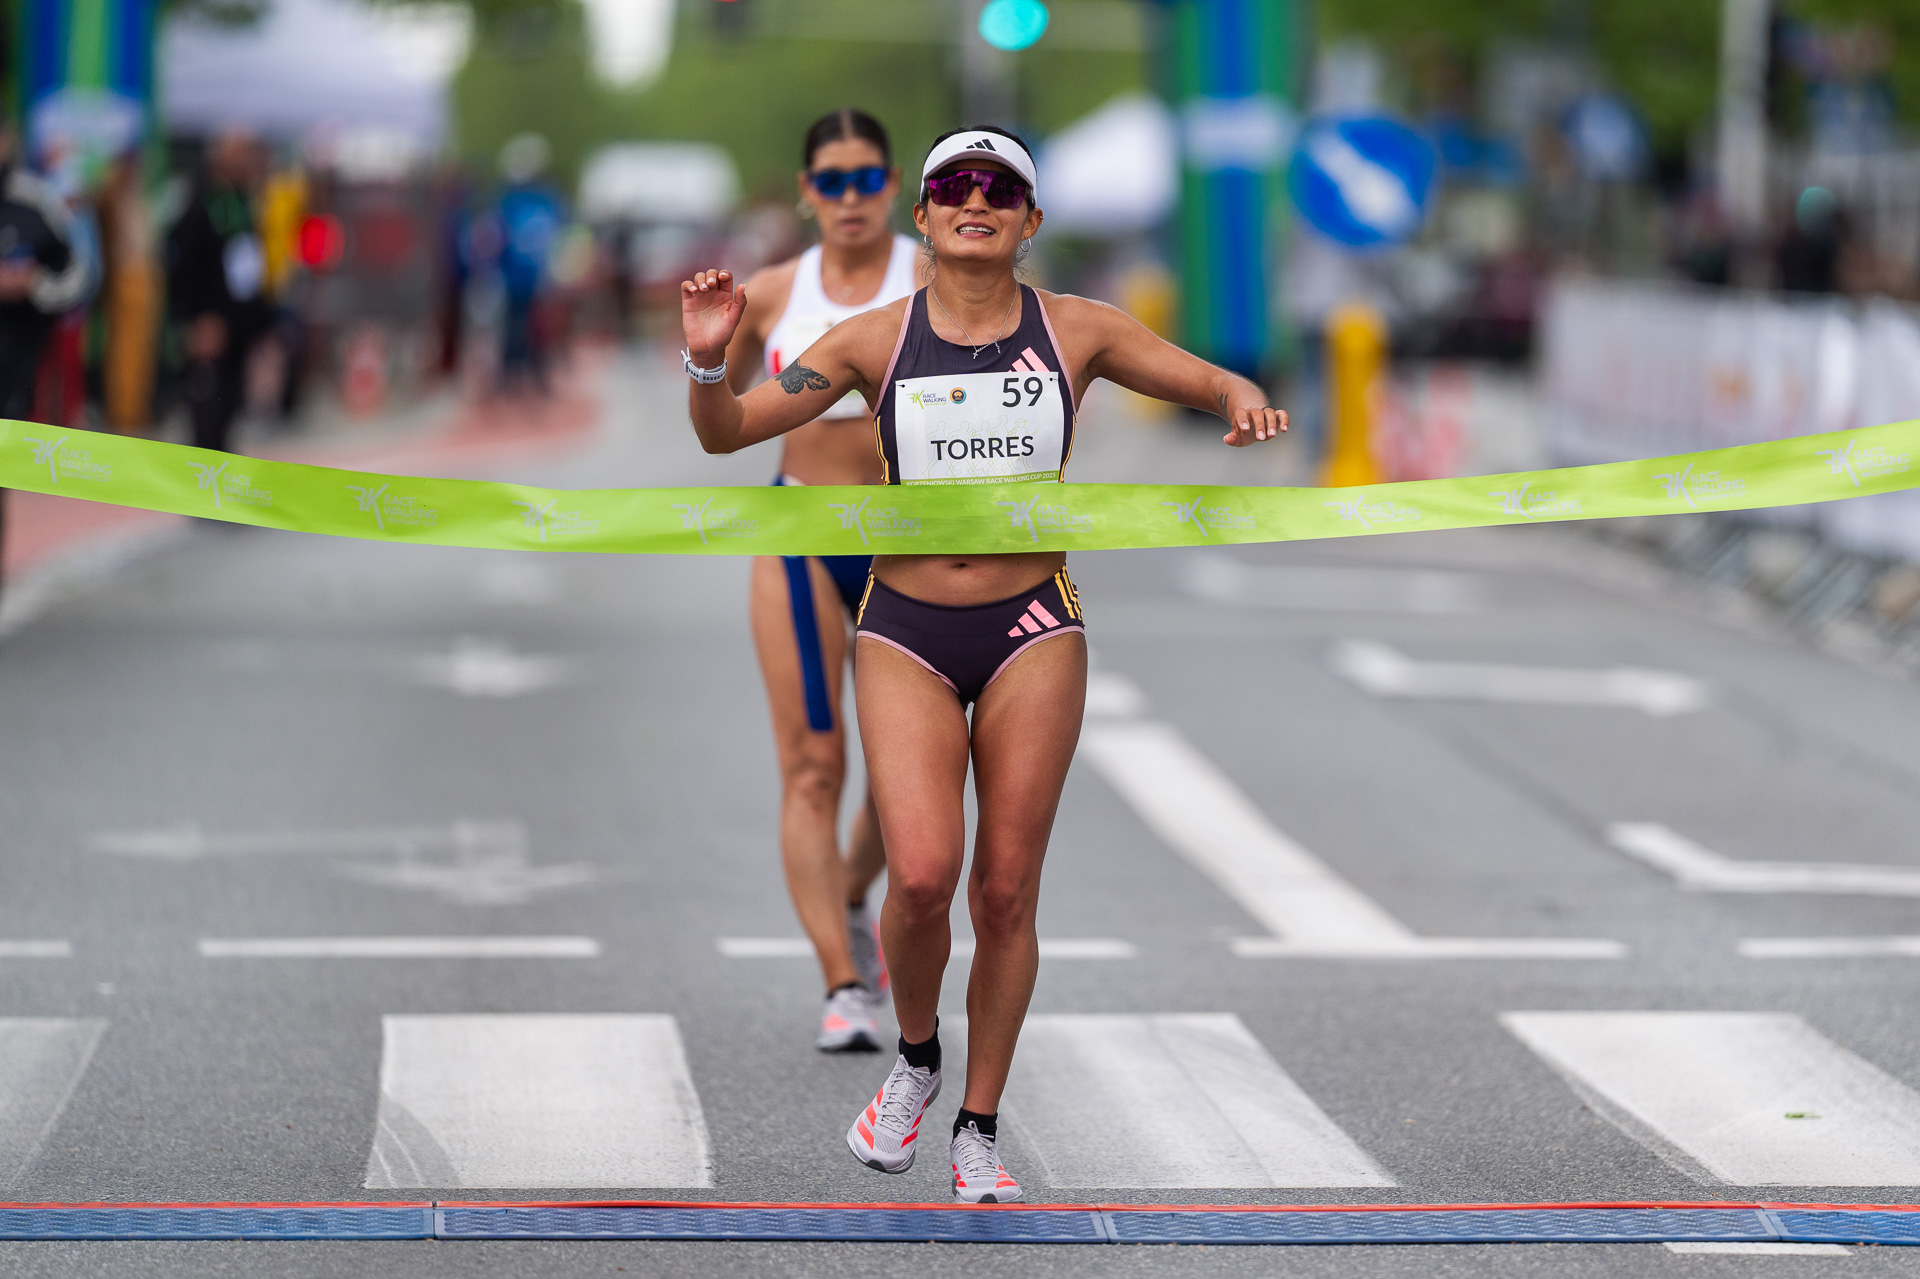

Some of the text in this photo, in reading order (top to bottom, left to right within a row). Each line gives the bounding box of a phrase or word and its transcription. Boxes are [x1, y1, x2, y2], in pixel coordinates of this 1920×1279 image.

[1002, 376, 1043, 408] 59
[60, 447, 92, 461] RACE
[930, 435, 1034, 461] TORRES
[1854, 446, 1886, 460] RACE
[60, 458, 111, 475] WALKING
[1855, 453, 1910, 470] WALKING
[1895, 464, 1910, 473] CUP
[223, 473, 252, 486] RACE
[1003, 475, 1030, 483] WALKING
[1690, 470, 1721, 484] RACE
[223, 483, 272, 500] WALKING
[1691, 478, 1745, 495] WALKING
[384, 494, 415, 506] RACE
[1527, 492, 1557, 503] RACE
[1036, 505, 1069, 515] RACE
[1200, 506, 1231, 516] RACE
[1362, 501, 1395, 511] RACE
[1527, 500, 1582, 512] WALKING
[384, 505, 438, 520] WALKING
[550, 510, 582, 520] RACE
[708, 507, 738, 519] RACE
[866, 507, 898, 518] RACE
[1364, 507, 1420, 519] WALKING
[550, 519, 600, 530] WALKING
[707, 519, 760, 530] WALKING
[866, 518, 922, 529] WALKING
[1037, 514, 1092, 526] WALKING
[1202, 515, 1256, 524] WALKING
[1075, 525, 1092, 533] CUP
